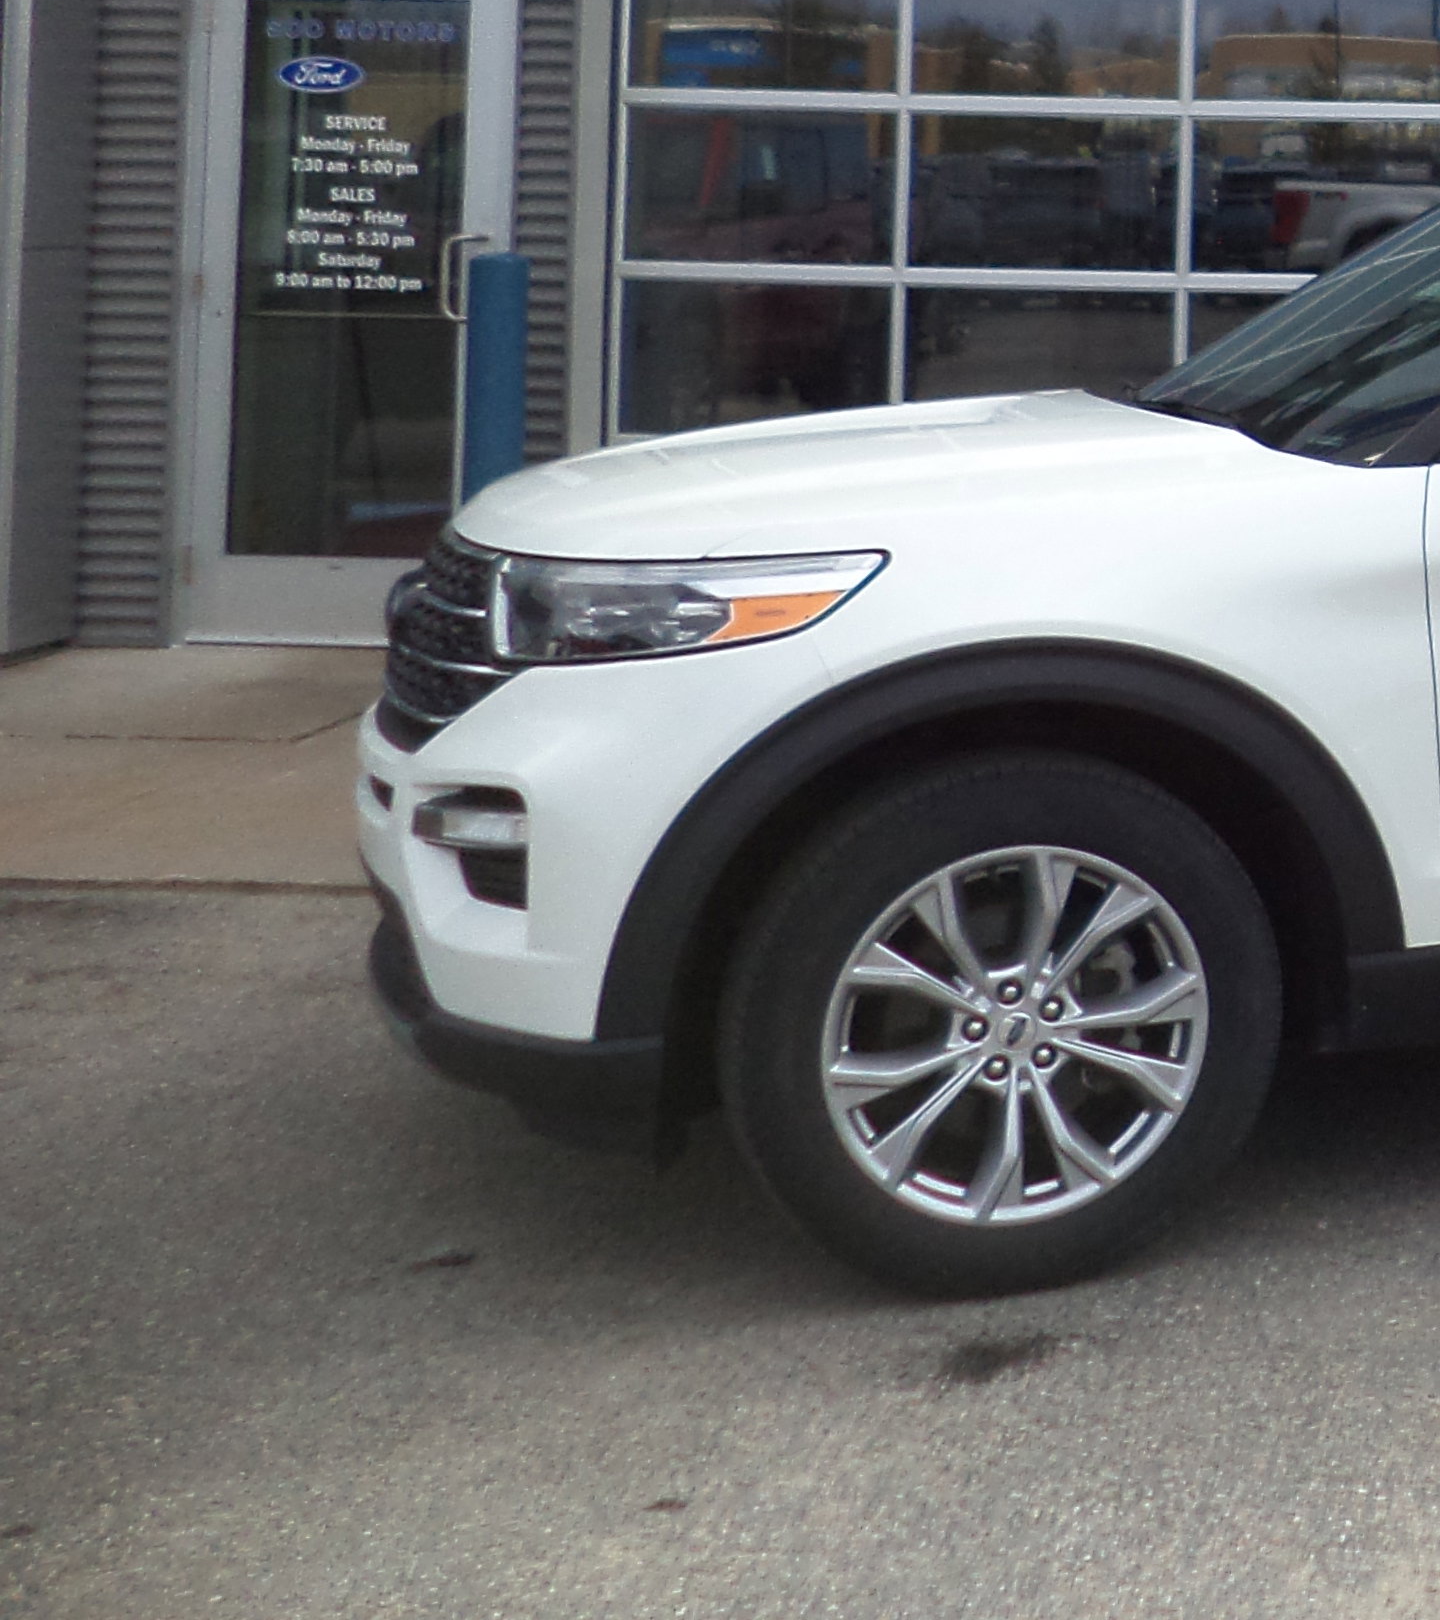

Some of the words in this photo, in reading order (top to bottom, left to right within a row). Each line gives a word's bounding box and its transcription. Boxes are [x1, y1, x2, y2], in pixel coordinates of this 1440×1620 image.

[266, 18, 324, 39] SOO
[335, 19, 455, 42] MOTORS
[294, 61, 347, 85] Ford
[325, 115, 387, 131] SERVICE
[300, 136, 356, 154] Monday
[367, 138, 411, 156] Friday
[291, 157, 323, 172] 7:30
[326, 161, 348, 173] am
[394, 163, 419, 177] pm
[329, 187, 376, 202] SALES
[296, 208, 353, 226] Monday
[363, 210, 408, 227] Friday
[286, 230, 320, 245] 8:00
[322, 233, 345, 246] am
[356, 231, 390, 246] 5:30
[392, 235, 416, 249] pm
[318, 251, 382, 270] Saturday
[275, 272, 309, 287] 9:00
[311, 276, 333, 288] am
[337, 275, 351, 288] to
[354, 275, 397, 290] 12:00
[399, 278, 423, 293] pm
